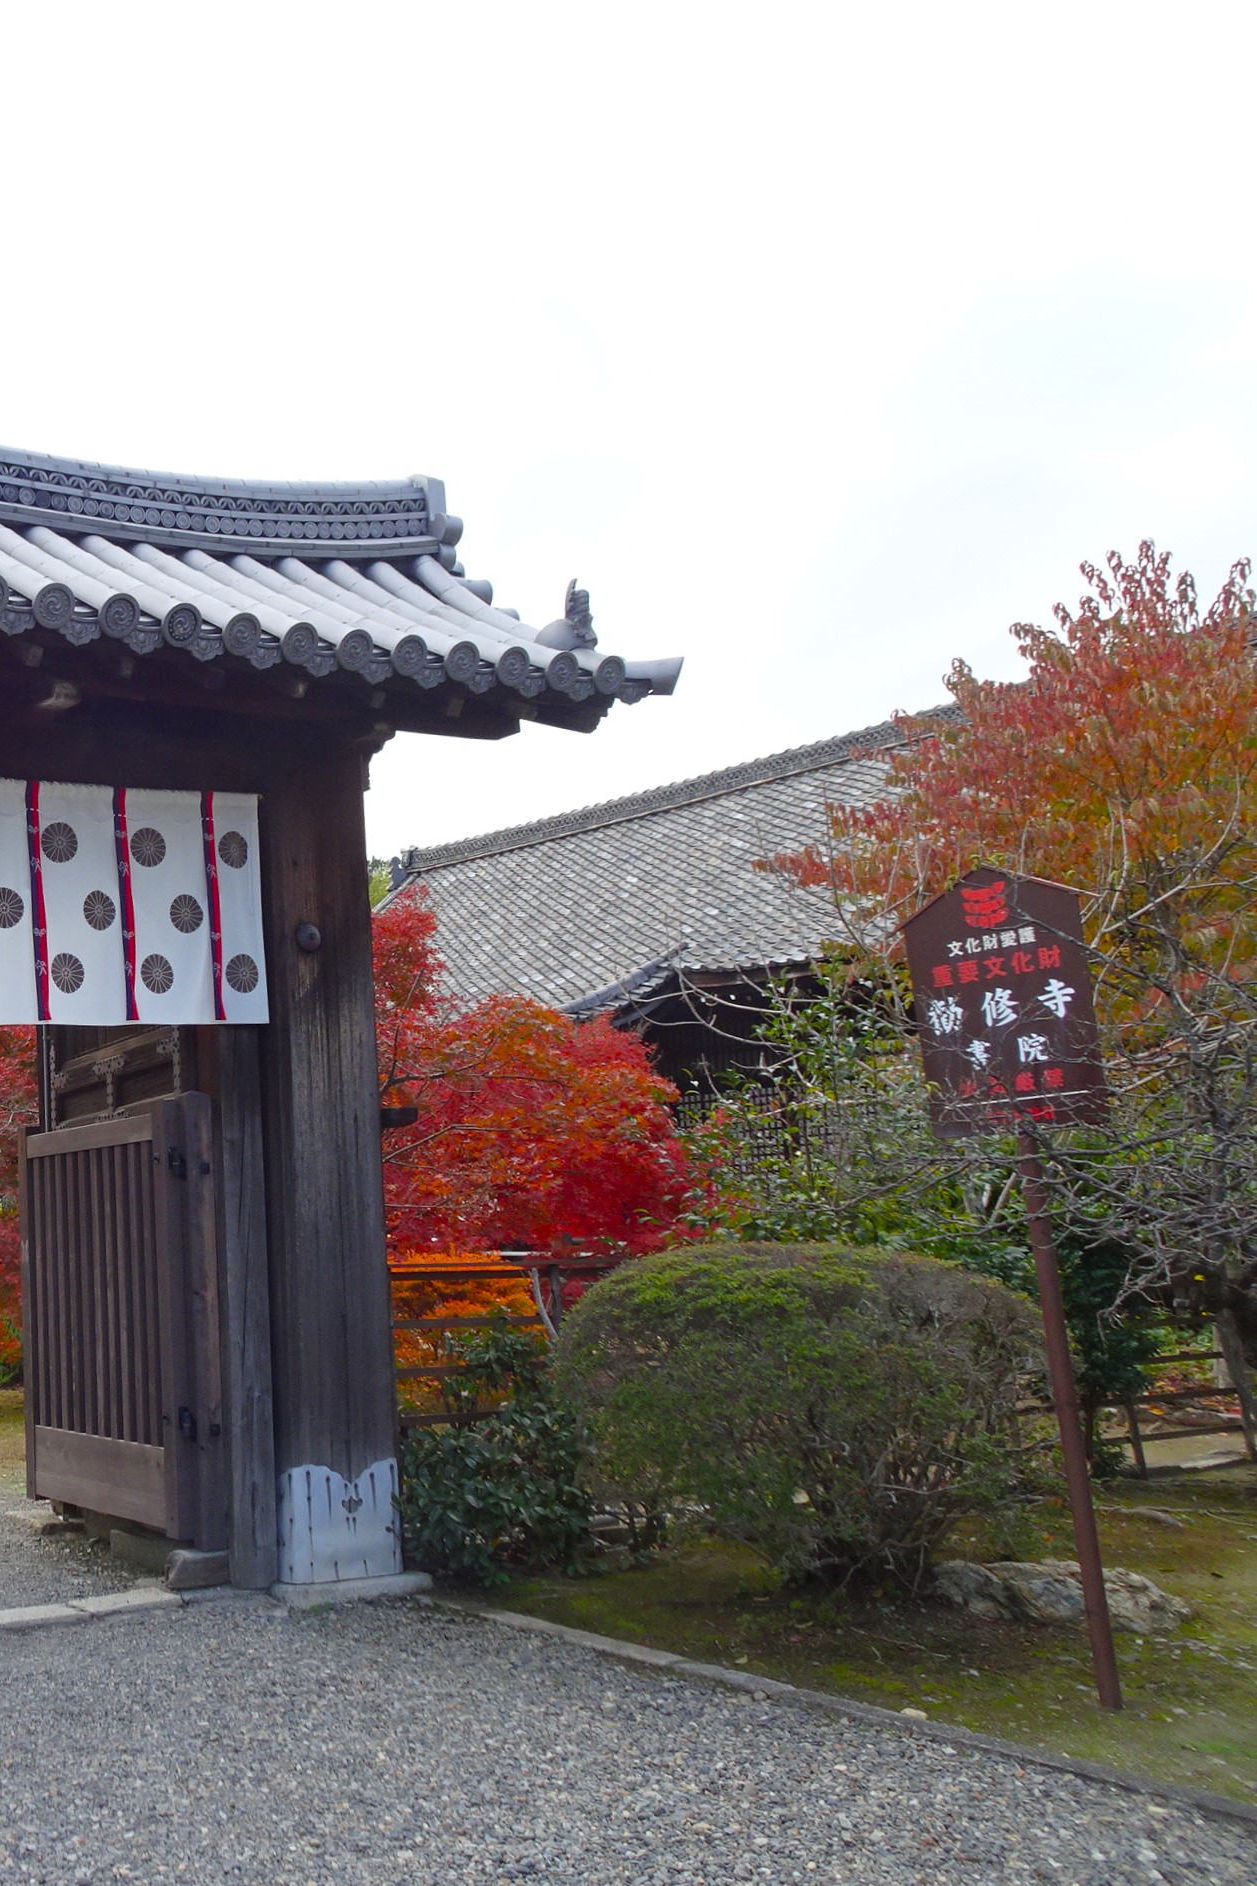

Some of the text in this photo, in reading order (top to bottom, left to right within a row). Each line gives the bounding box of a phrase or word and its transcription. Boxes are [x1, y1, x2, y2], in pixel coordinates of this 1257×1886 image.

[947, 927, 1036, 958] 文化財愛護
[931, 945, 1061, 988] 重要文化財
[966, 1034, 1049, 1071] 書院
